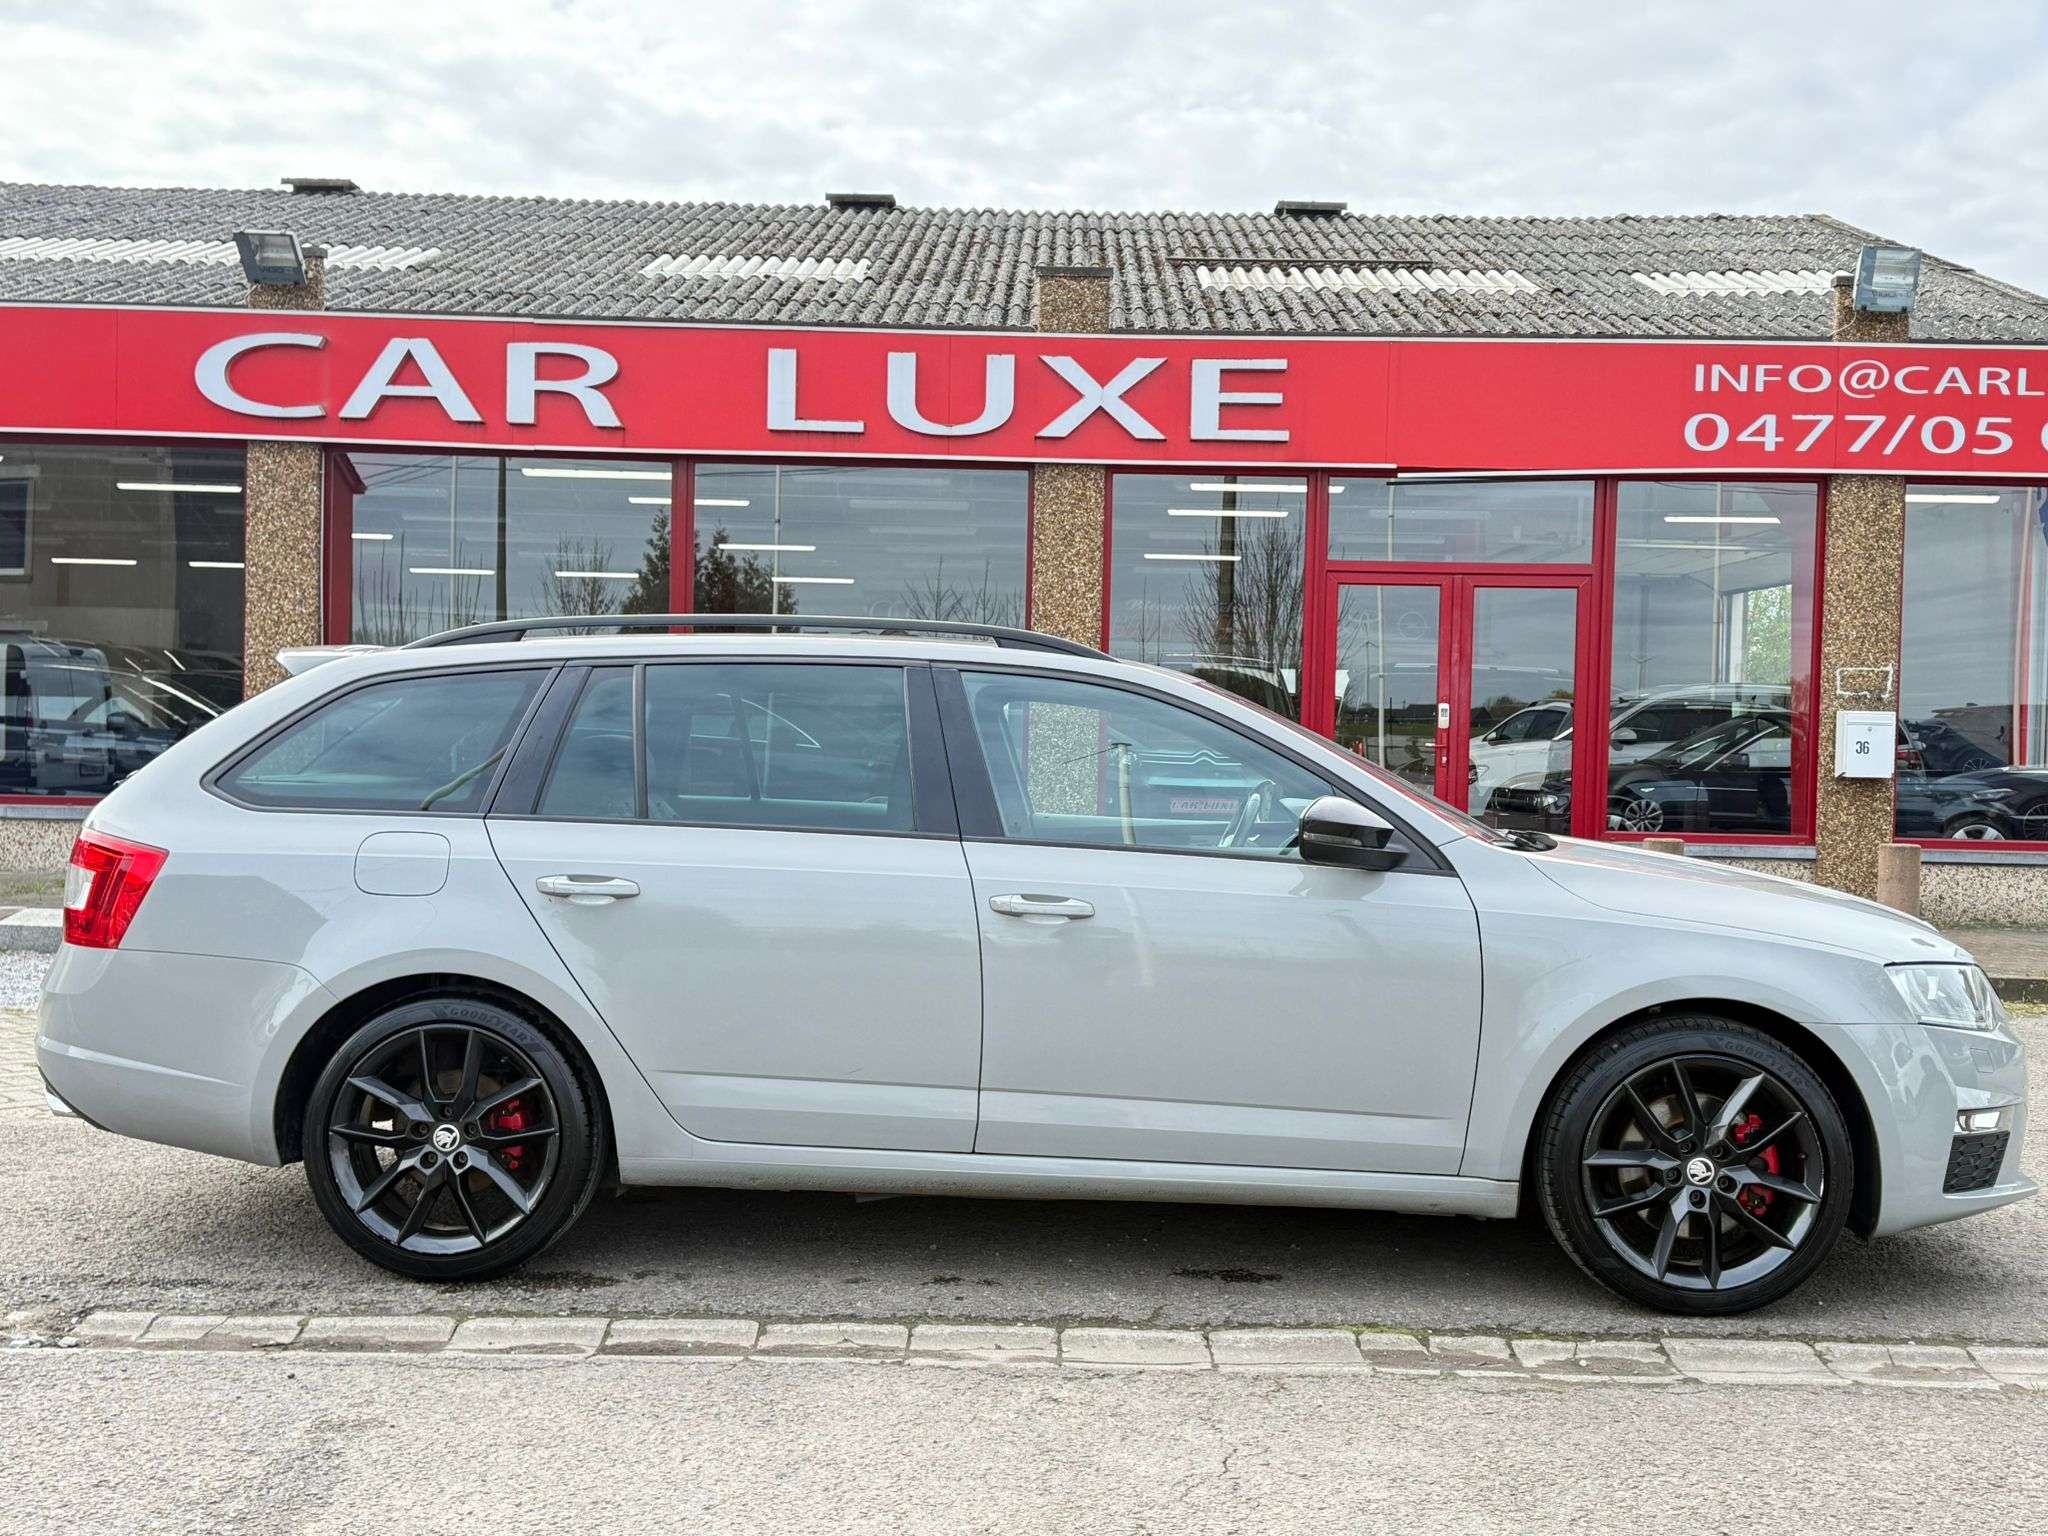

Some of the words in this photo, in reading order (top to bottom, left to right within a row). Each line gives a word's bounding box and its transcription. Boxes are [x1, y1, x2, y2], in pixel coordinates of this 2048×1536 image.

[194, 332, 626, 429] CAR
[767, 347, 1291, 442] LUXE
[1694, 359, 2046, 398] INFO@CARL
[1684, 412, 2014, 456] 0477/05
[1855, 740, 1870, 755] 36
[449, 1006, 529, 1043] GOODYEAR
